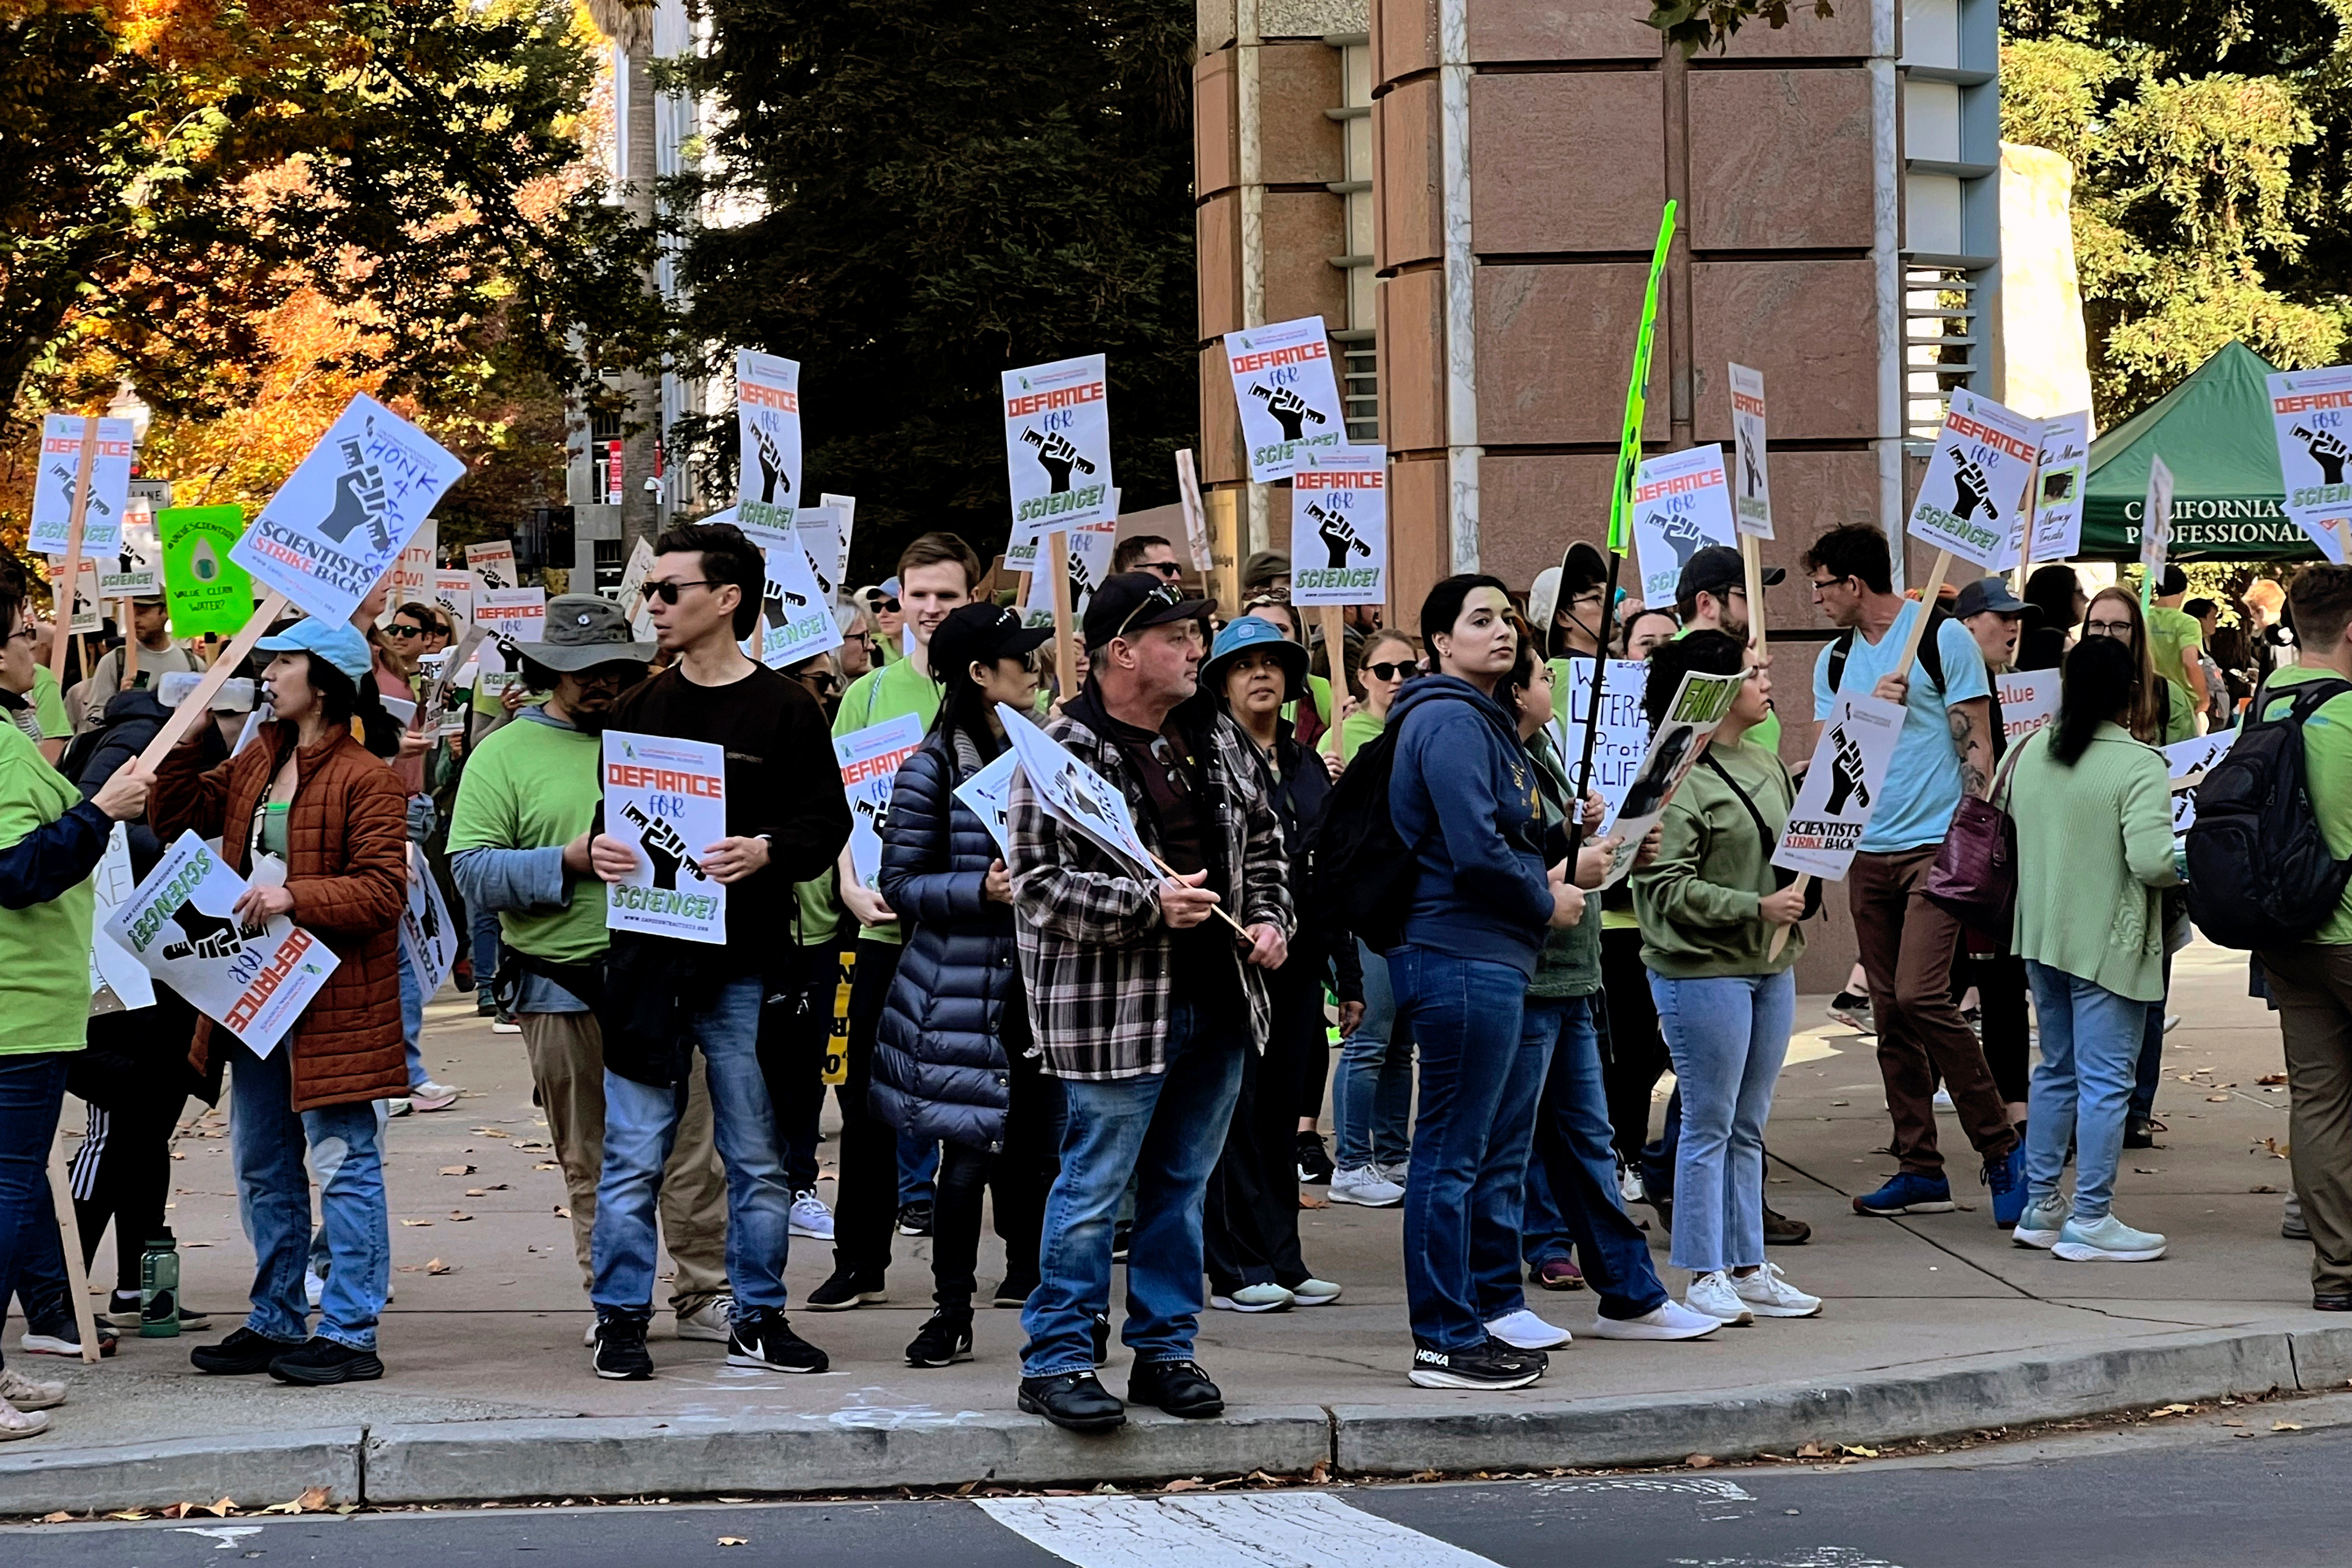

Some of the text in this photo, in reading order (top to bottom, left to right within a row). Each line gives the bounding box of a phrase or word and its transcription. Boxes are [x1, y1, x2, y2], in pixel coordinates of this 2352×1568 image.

[1232, 341, 1327, 374] DEFIANCE
[1270, 366, 1300, 386] FOR
[739, 381, 797, 413] DEFIANCE
[1008, 382, 1103, 417] DEFIANCE
[761, 410, 780, 433] FOR
[1044, 410, 1074, 432] FOR
[2312, 411, 2343, 429] FOR
[44, 438, 130, 456] DEFNCE
[1946, 412, 2036, 463] DEFIANCE
[365, 439, 438, 495] HONK
[1971, 446, 1999, 469] FOR
[394, 480, 408, 499] 4
[1296, 472, 1383, 489] DEFIANCE
[1635, 468, 1724, 504] DEFIANCE
[1017, 483, 1106, 521] SCIENCE!
[1327, 492, 1354, 509] FOR
[1667, 494, 1696, 514] FOR
[2124, 500, 2279, 521] CIFORNIA
[737, 498, 794, 531] SCIENCE!
[1915, 503, 2001, 552] SCIENCE!
[2125, 524, 2310, 544] PFESSIONAL
[259, 521, 374, 583] SCIENTISTS
[468, 551, 513, 564] DEFIANCE
[254, 537, 315, 574] STRIKE
[314, 565, 365, 596] BACK
[1295, 567, 1379, 588] SCIENCE!
[101, 572, 154, 587] SCIENCE!
[476, 605, 544, 619] DEFIANCE
[501, 620, 522, 632] FOR
[1572, 690, 1648, 727] LTERA
[608, 763, 722, 799] DEFIANCE
[649, 794, 686, 818] FOR
[1787, 820, 1863, 838] SCIENTISTS
[1785, 836, 1857, 850] STRIKE BACK
[127, 848, 213, 952] SCIENCE!
[611, 884, 718, 920] SCIENCE!
[227, 946, 263, 984] FOR
[224, 928, 313, 1034] DEFIANCE
[1416, 1349, 1449, 1367] HOKA
